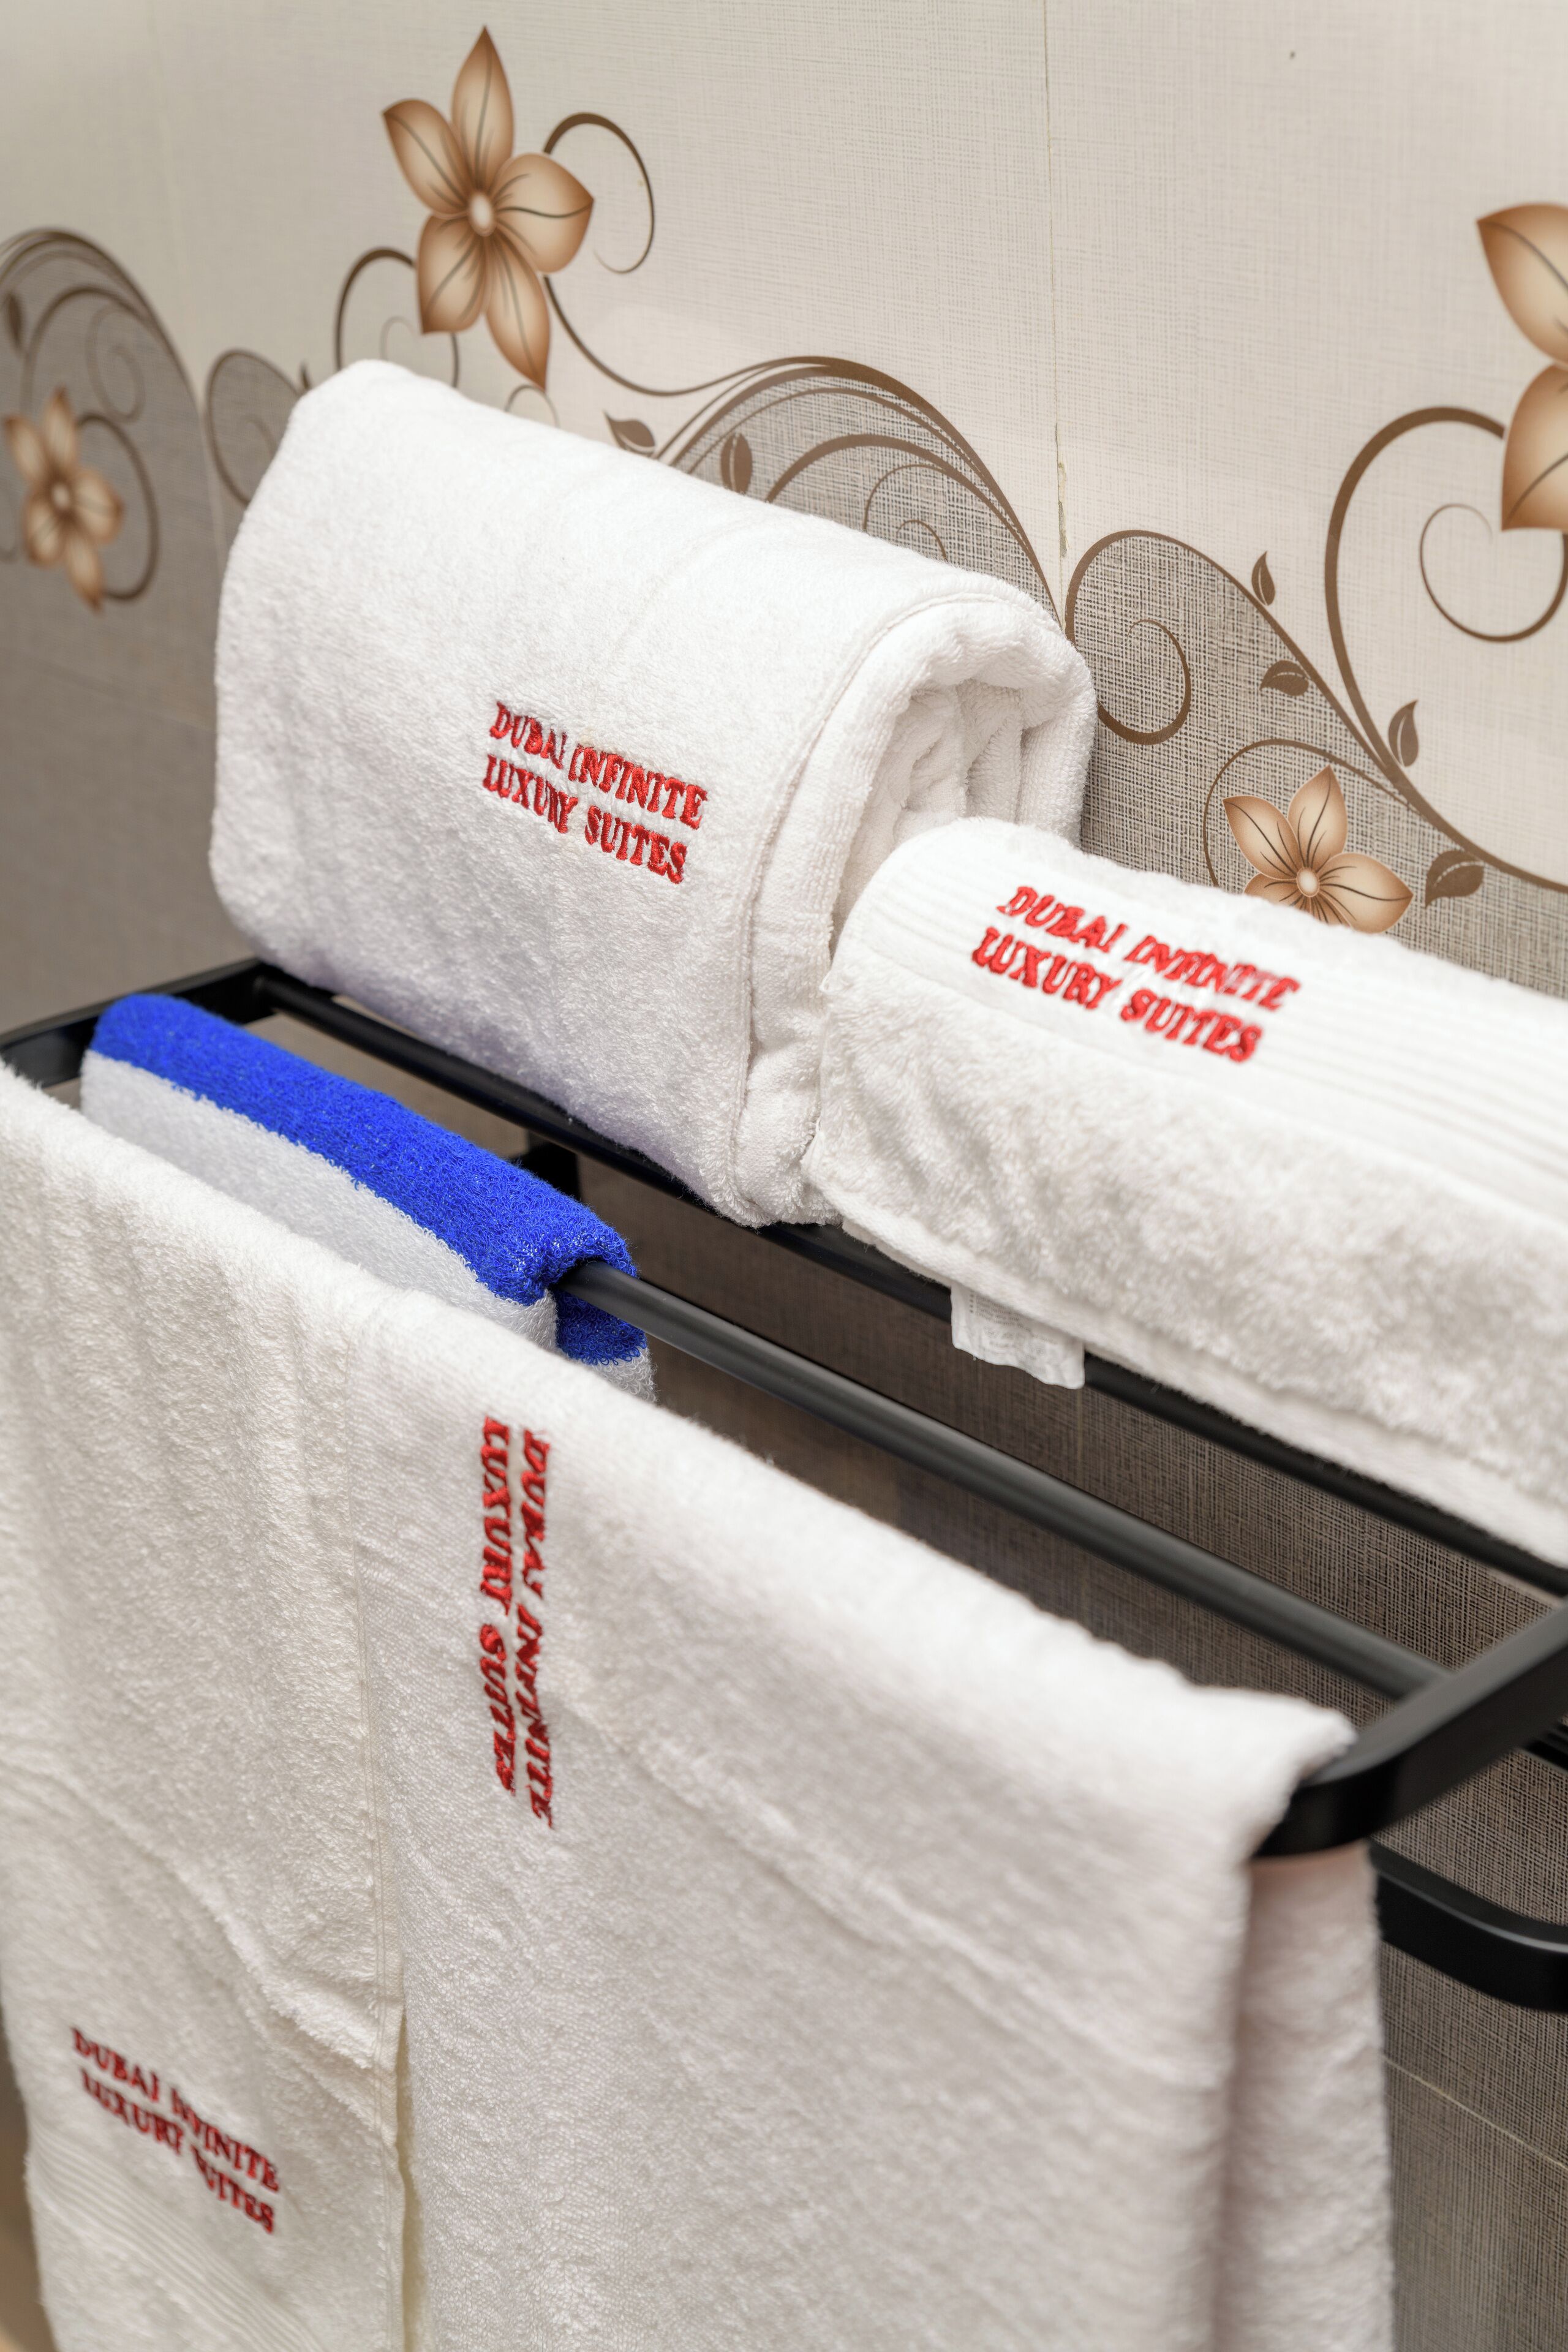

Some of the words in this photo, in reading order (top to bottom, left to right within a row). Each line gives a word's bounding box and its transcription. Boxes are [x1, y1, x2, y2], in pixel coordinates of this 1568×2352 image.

[489, 701, 568, 769] DUBAI
[567, 743, 708, 830] INFINITE
[584, 804, 688, 884] SUITES
[971, 927, 1121, 1009] LUXURY
[1120, 988, 1263, 1064] SUITES
[997, 886, 1128, 953] DUBAI
[1123, 935, 1301, 1011] INFINITE
[479, 1416, 513, 1616] LUXURY
[479, 1623, 517, 1797] SUITES
[72, 2028, 161, 2102] DUBAI
